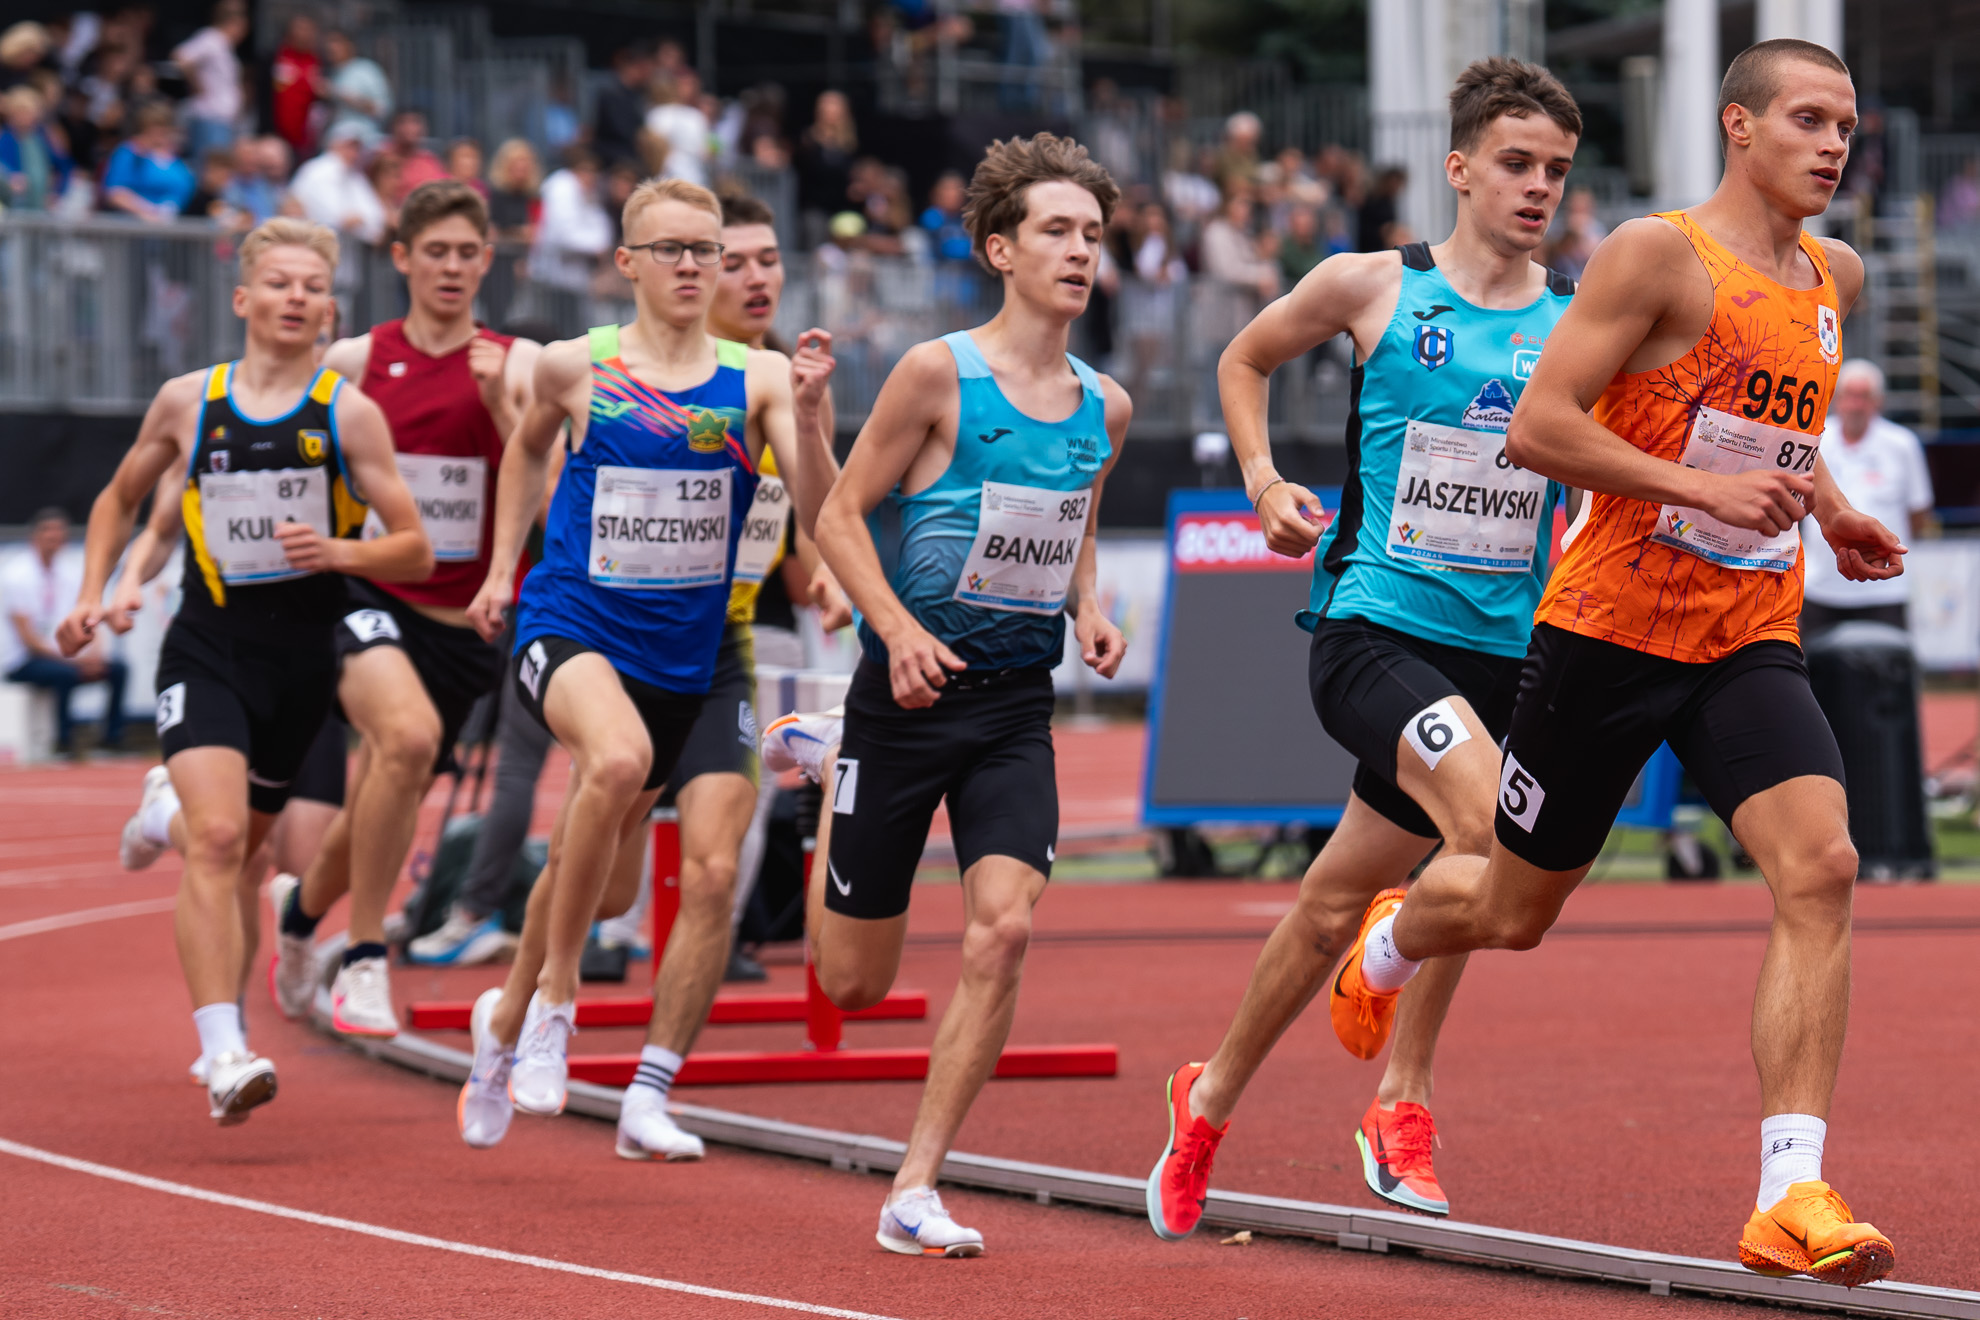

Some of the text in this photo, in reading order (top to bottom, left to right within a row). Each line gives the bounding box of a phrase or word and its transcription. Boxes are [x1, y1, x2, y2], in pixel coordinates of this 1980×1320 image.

[1743, 369, 1819, 430] 956
[1430, 437, 1468, 448] Ministerstwo
[1718, 434, 1738, 447] Sportu
[1742, 440, 1766, 454] Turystyki
[1720, 427, 1757, 443] Ministerstwo
[1429, 443, 1449, 453] Sportu
[439, 464, 468, 486] 98
[278, 477, 309, 499] 87
[676, 478, 722, 501] 128
[1401, 476, 1539, 520] JASZEWSKI
[1057, 497, 1087, 522] 982
[598, 514, 726, 543] STARCZEWSKI
[983, 534, 1077, 566] BANIAK
[1411, 549, 1443, 560] POZNAŃ
[361, 611, 388, 634] 2
[1417, 712, 1453, 753] 6
[835, 763, 849, 807] 7
[1504, 767, 1535, 816] 5
